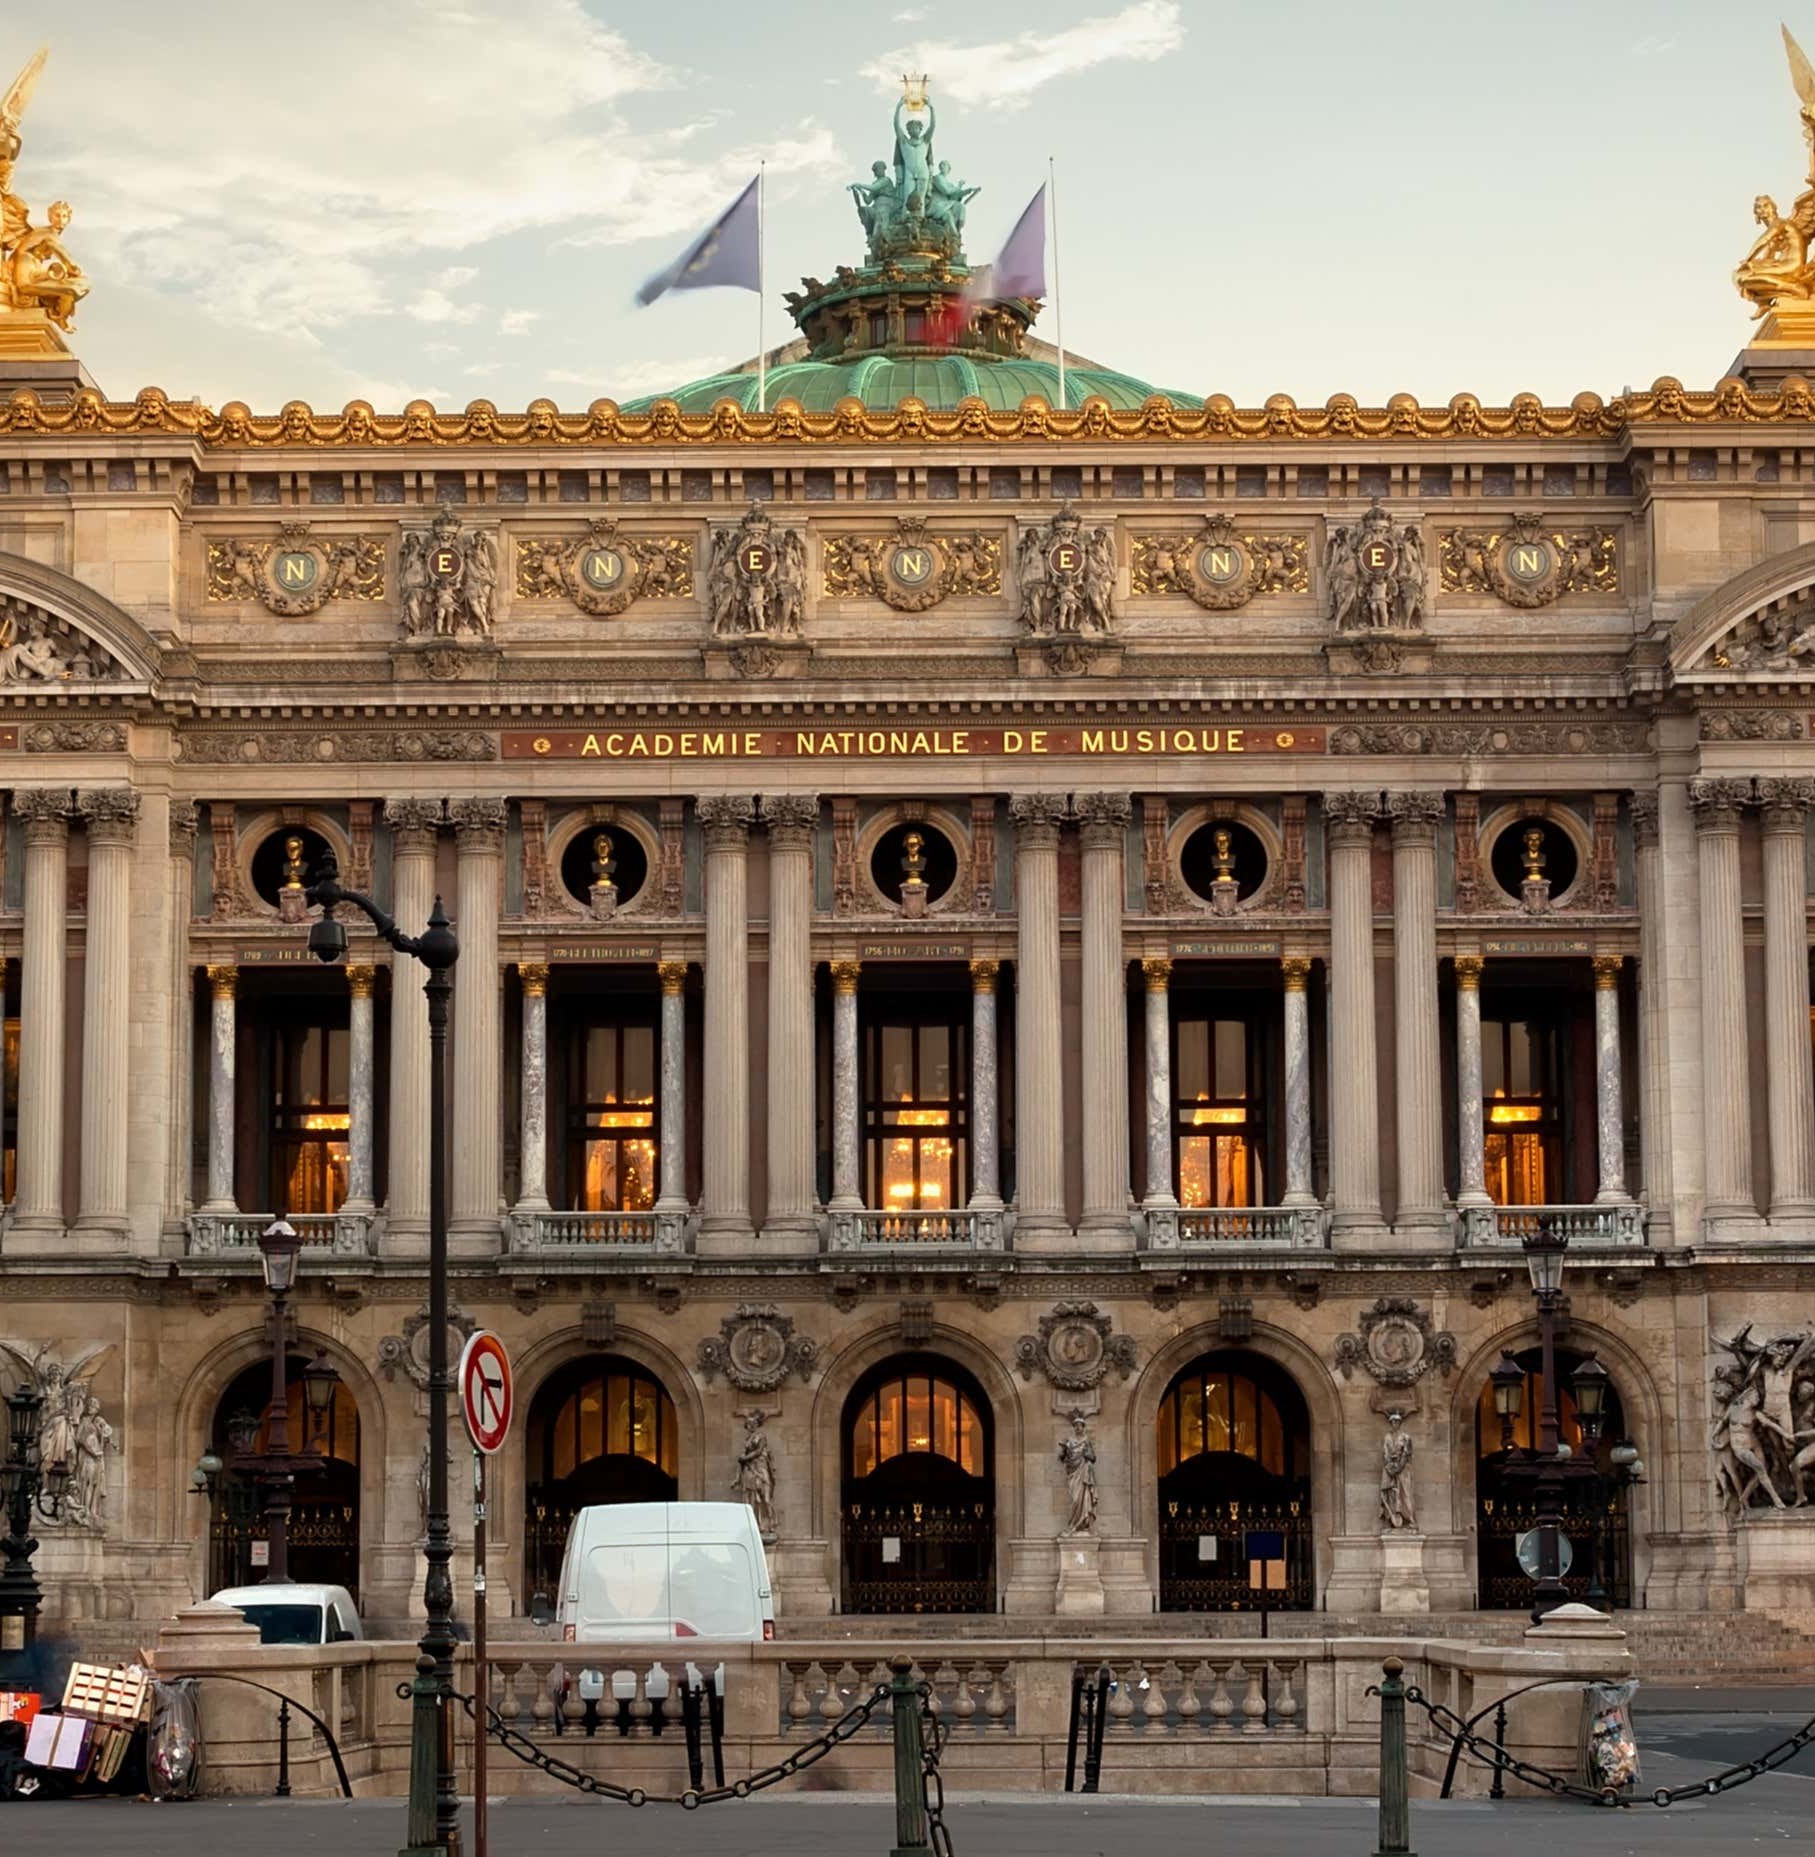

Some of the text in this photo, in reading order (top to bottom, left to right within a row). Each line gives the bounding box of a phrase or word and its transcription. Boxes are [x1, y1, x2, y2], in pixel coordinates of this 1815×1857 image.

[438, 554, 453, 572] E
[595, 556, 614, 578] N
[749, 551, 764, 570] E
[903, 554, 921, 576] N
[1060, 550, 1075, 569] E
[1211, 553, 1230, 574] N
[1371, 548, 1386, 567] E
[1519, 551, 1538, 572] N
[286, 559, 305, 581] N
[581, 730, 1245, 756] ACADEMIE NATIONALE DE MUSIQUE
